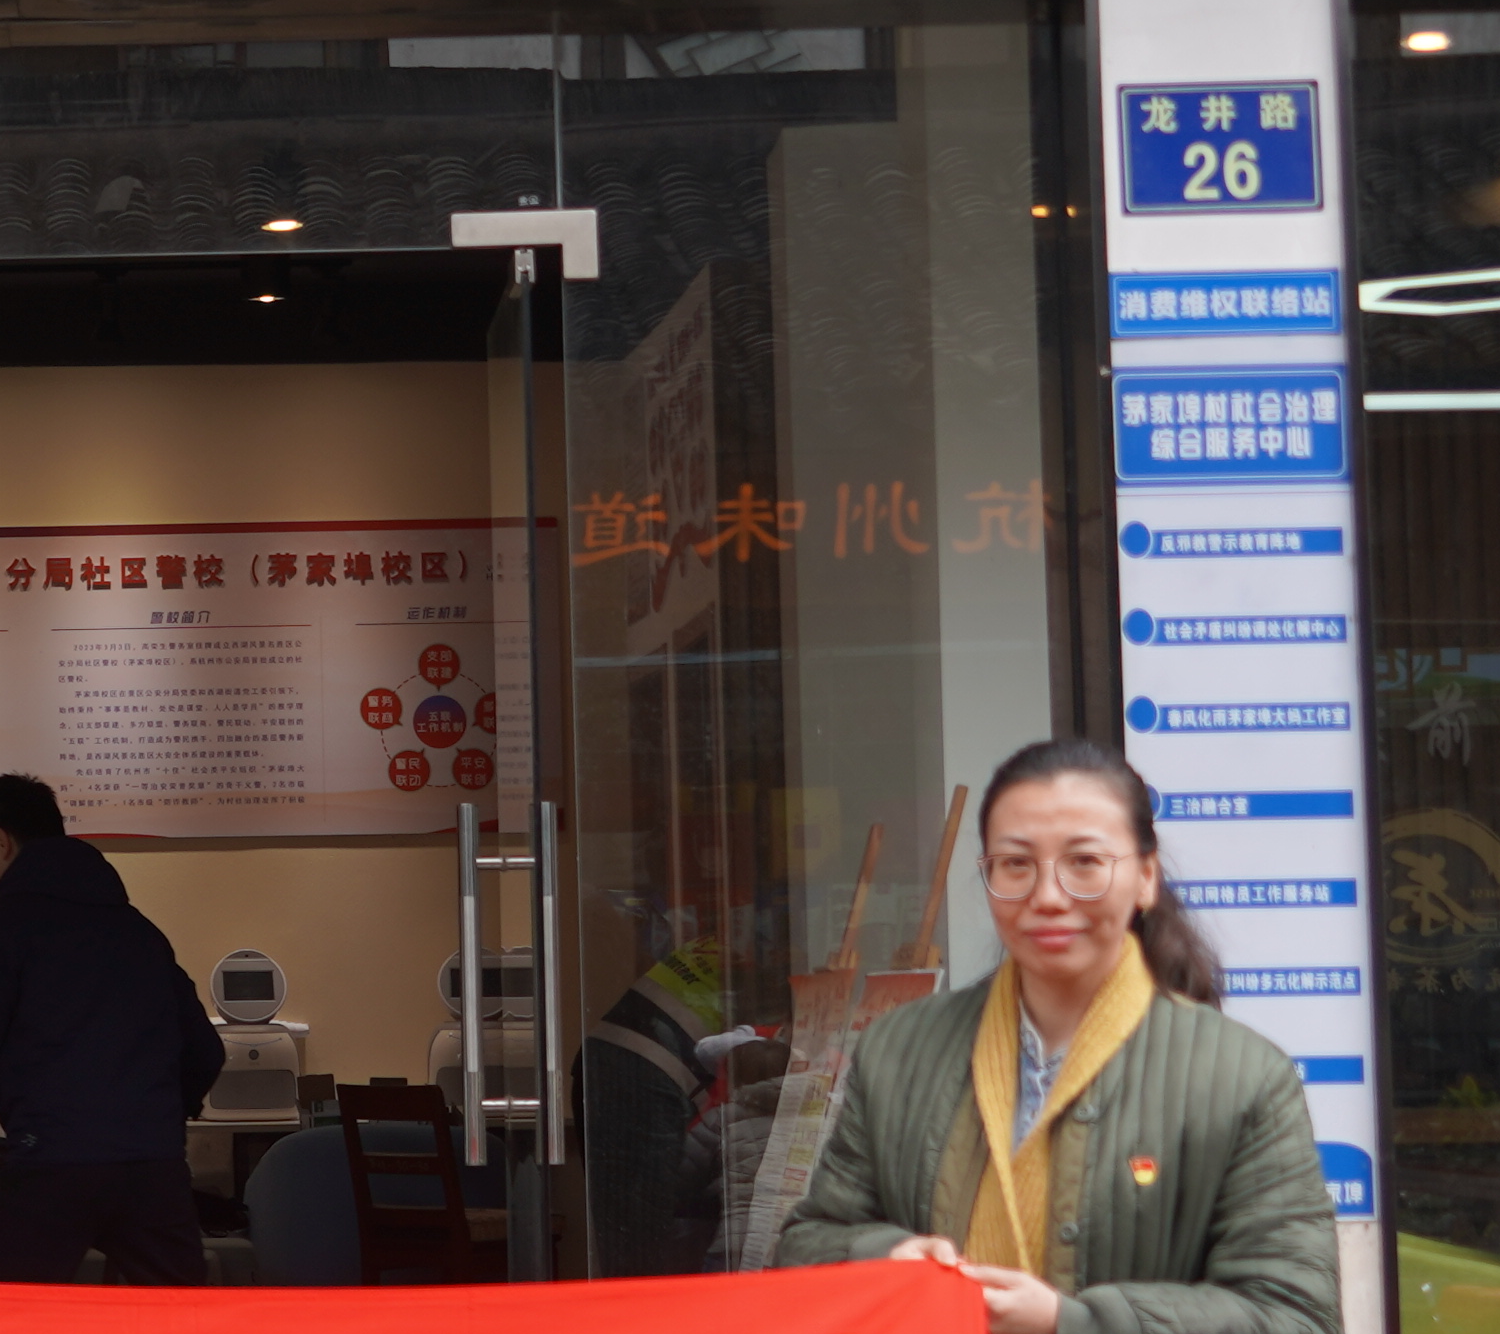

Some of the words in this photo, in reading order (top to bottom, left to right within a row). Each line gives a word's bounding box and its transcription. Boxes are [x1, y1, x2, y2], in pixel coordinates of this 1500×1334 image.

[1140, 93, 1296, 134] 龙井路
[1183, 142, 1260, 200] 26
[1119, 286, 1331, 320] 消费维权联络站
[1122, 389, 1337, 427] 茅家埠村社会治理
[1151, 425, 1312, 460] 综合服务中心
[1161, 532, 1300, 553] 反邪教警示教育阵地
[406, 606, 467, 620] 运作机制
[1170, 797, 1249, 816] 三治融合室
